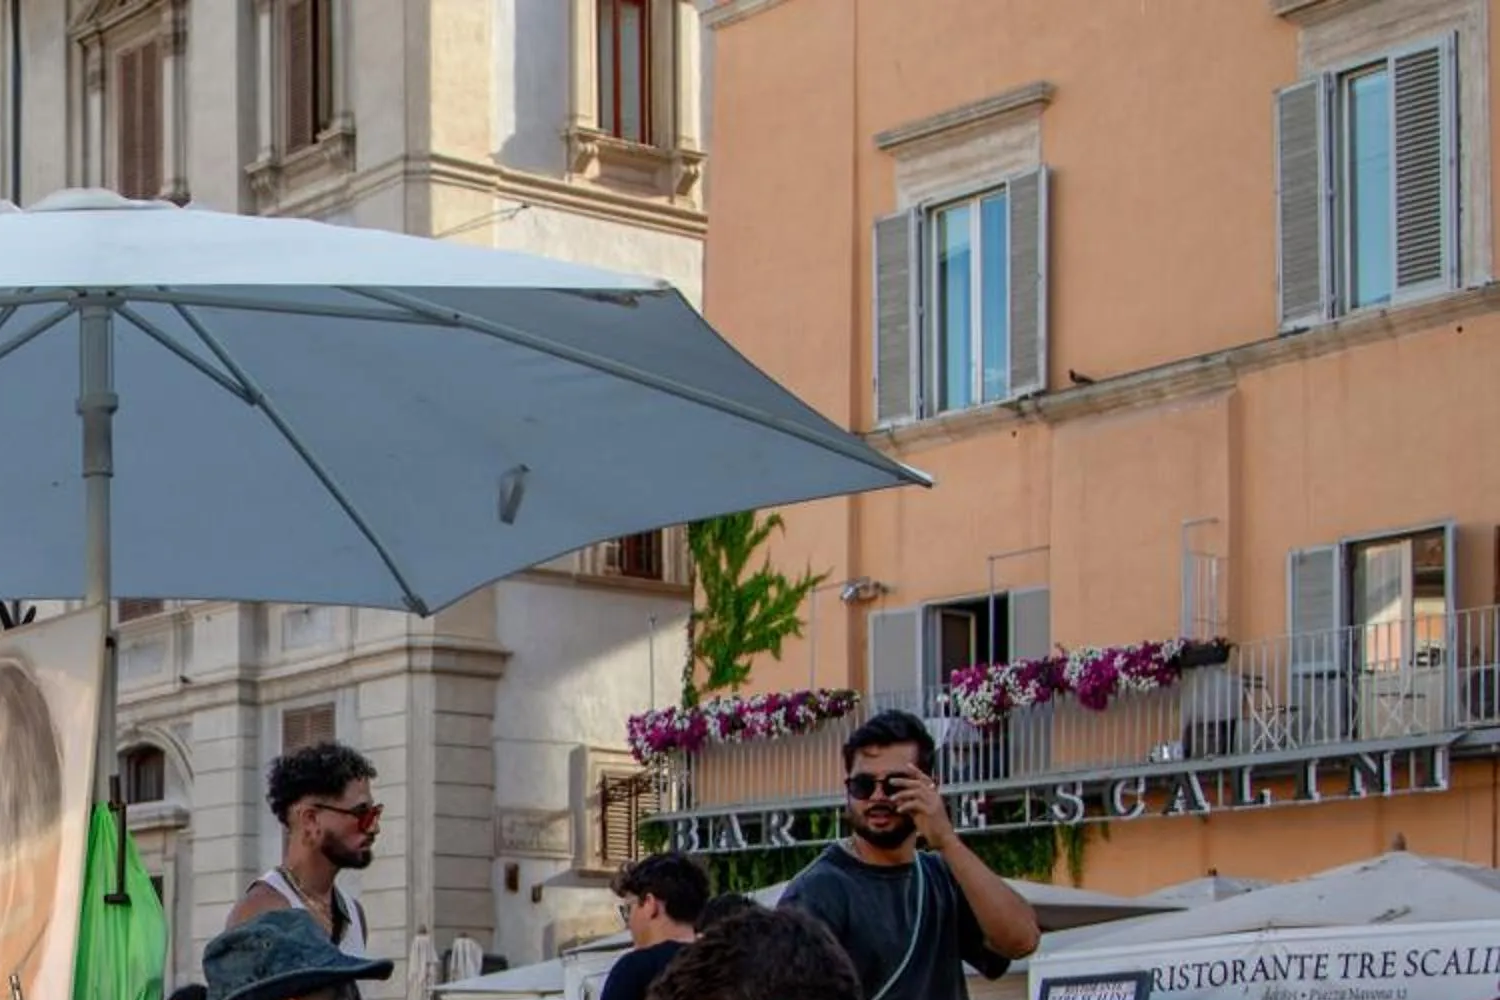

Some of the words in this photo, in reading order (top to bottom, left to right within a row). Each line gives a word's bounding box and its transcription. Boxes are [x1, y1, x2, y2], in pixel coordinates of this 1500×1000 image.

[670, 811, 797, 852] BAR
[1050, 746, 1450, 824] SCALINI
[1150, 953, 1329, 993] RISTORANTE
[1338, 949, 1397, 980] TRE
[1404, 946, 1500, 977] SCALI
